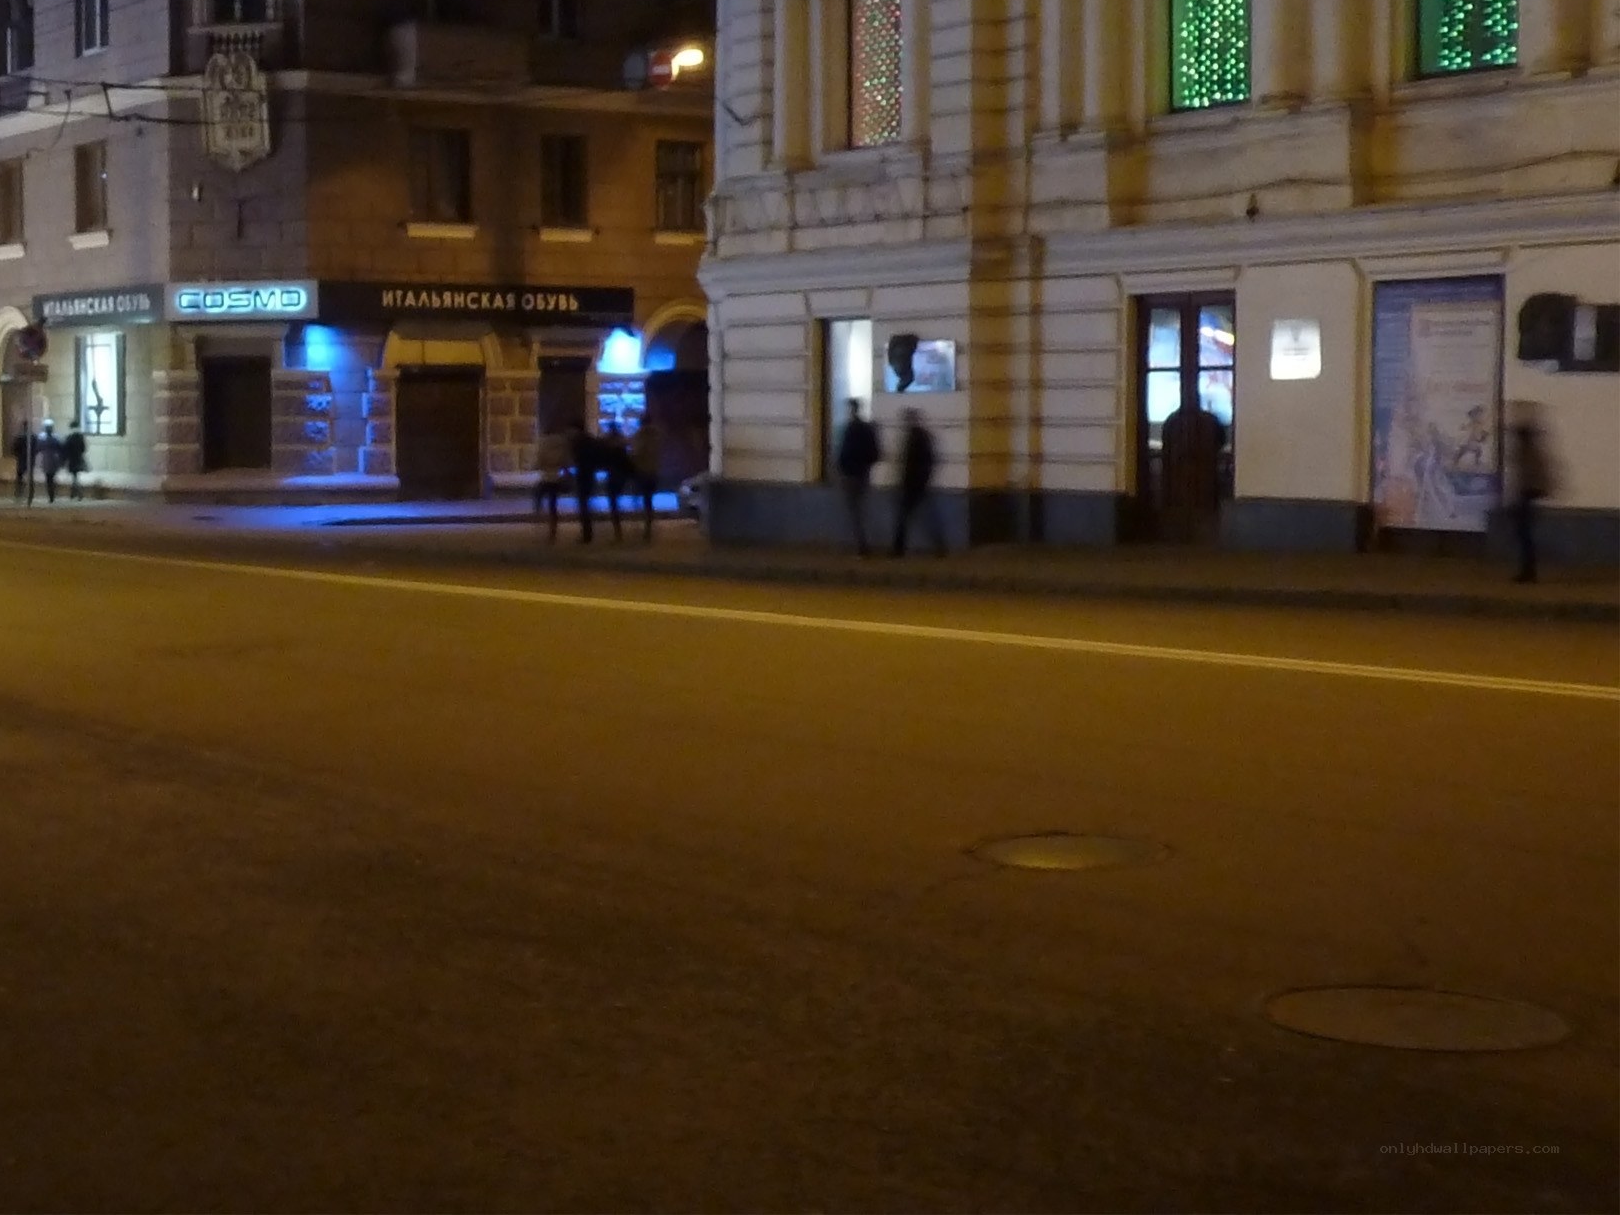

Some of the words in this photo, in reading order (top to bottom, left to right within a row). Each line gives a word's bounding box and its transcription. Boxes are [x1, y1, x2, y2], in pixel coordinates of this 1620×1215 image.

[42, 296, 115, 317] ИТАЛЬЯНСКАЯ
[116, 293, 151, 314] ОБУВЬ
[179, 288, 304, 311] COSMO
[382, 289, 516, 311] ИТАЛЬЯНСКАЯ
[521, 291, 579, 311] ОБУВЬ
